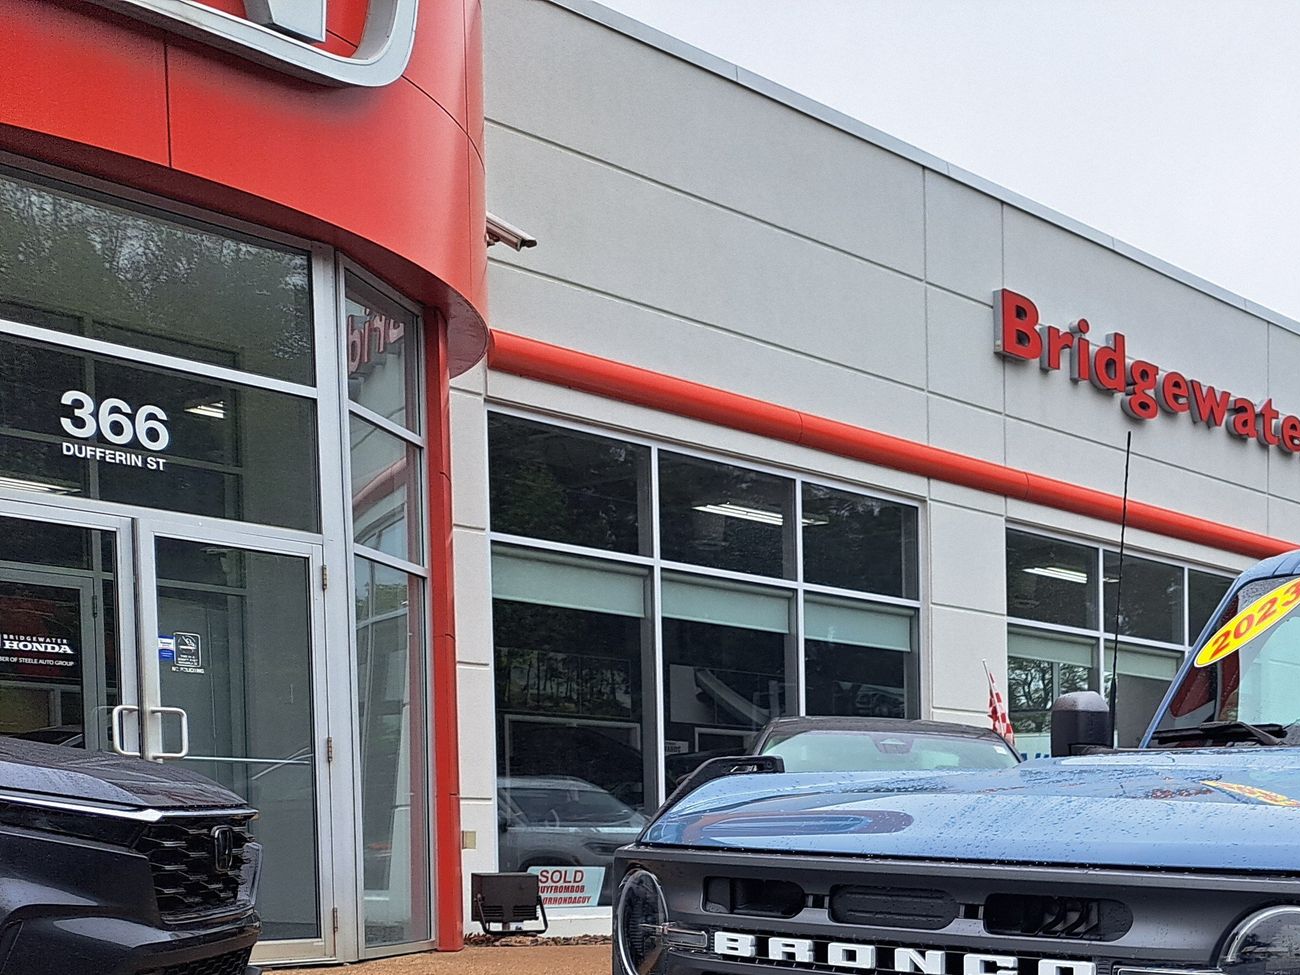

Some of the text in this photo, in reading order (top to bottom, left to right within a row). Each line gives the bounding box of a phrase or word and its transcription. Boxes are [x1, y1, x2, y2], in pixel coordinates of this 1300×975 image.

[59, 390, 170, 451] 366
[62, 441, 167, 471] DUFFERIN ST
[3, 633, 68, 645] BRIDGEWATER
[3, 639, 75, 654] HONDA
[539, 869, 585, 884] SOLD
[537, 885, 586, 895] UYFROMBOB
[543, 896, 592, 905] URHONDAGUY
